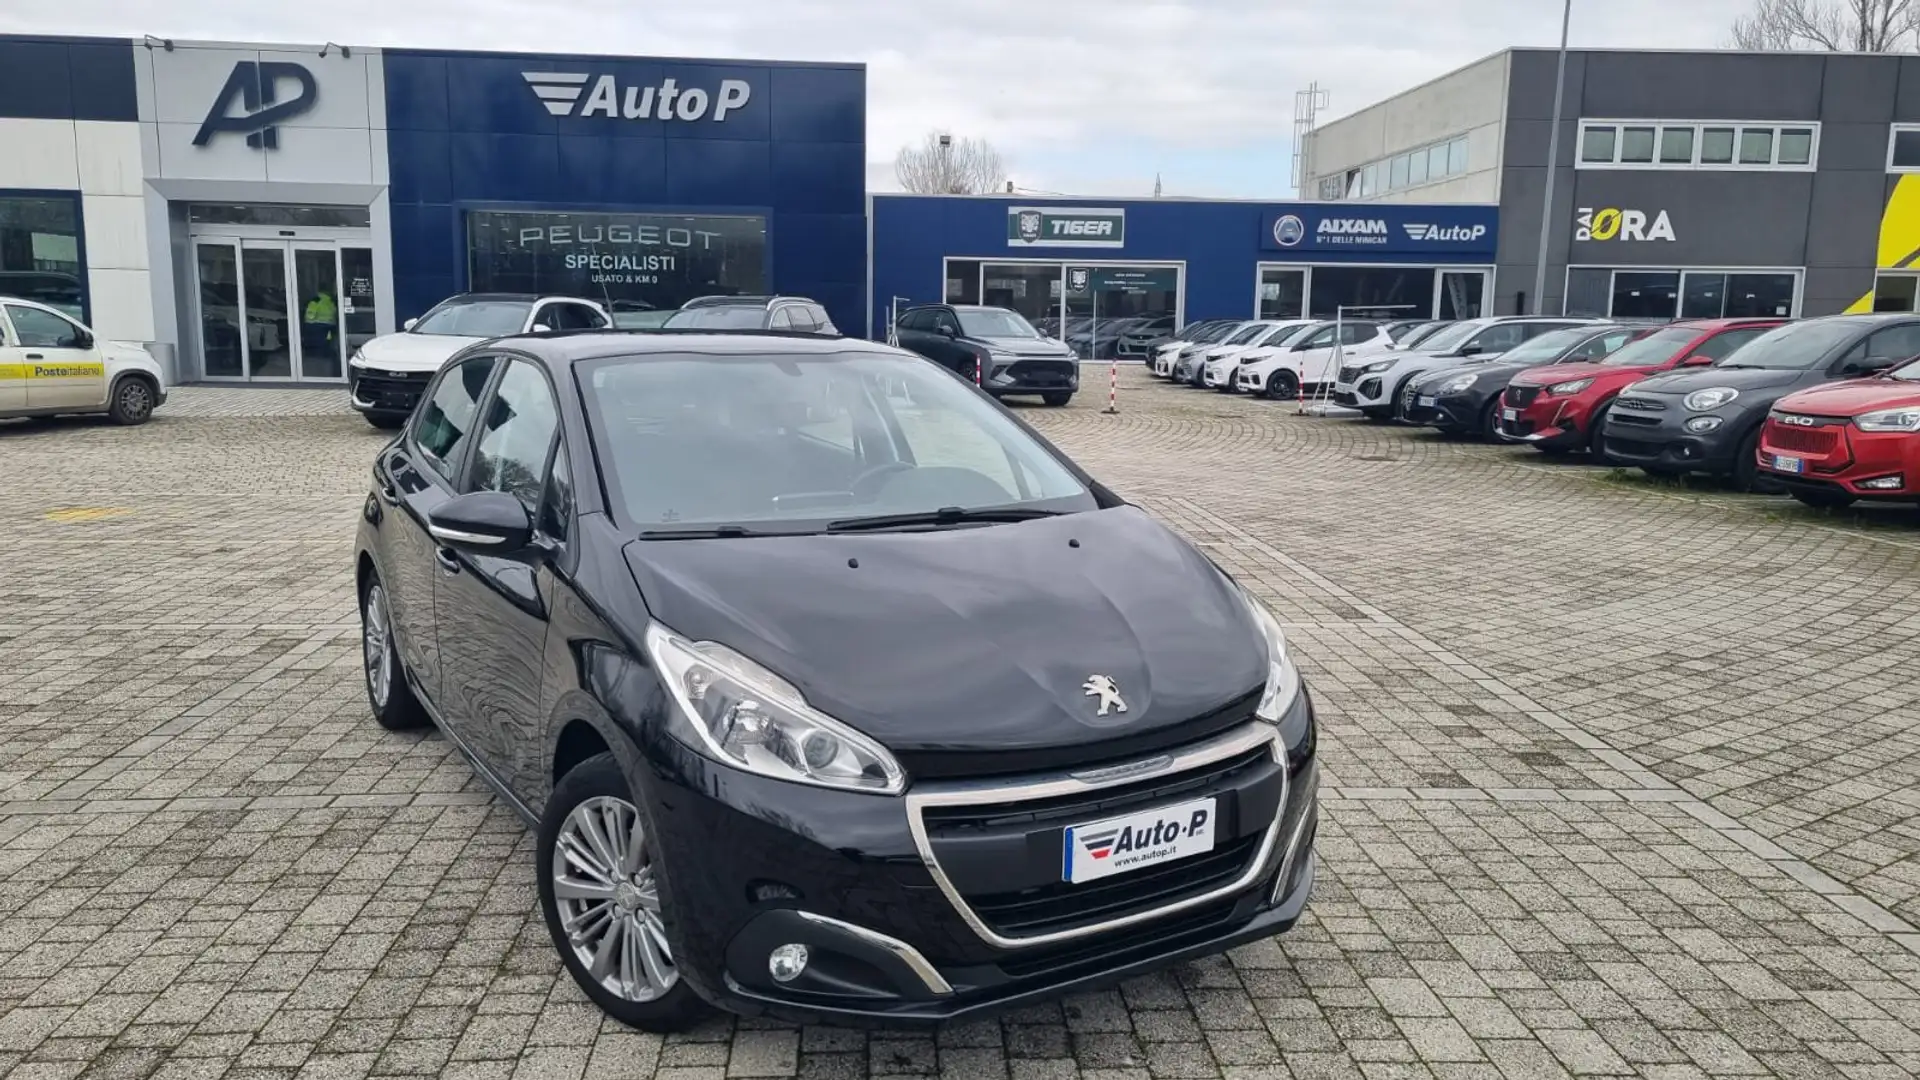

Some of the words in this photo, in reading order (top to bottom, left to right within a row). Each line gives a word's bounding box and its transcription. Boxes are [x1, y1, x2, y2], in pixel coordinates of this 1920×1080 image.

[191, 61, 317, 149] AP
[580, 74, 708, 121] Auto
[1051, 219, 1113, 235] TIGER
[1317, 219, 1388, 234] AIXAM
[1575, 207, 1593, 241] DAI
[519, 224, 722, 250] PEUGEOT
[1331, 235, 1354, 244] DELLE
[564, 254, 675, 270] SPECIALISTI
[591, 274, 624, 283] USATO
[625, 274, 633, 283] &
[635, 275, 650, 283] KM
[1114, 846, 1177, 867] www.autop.it
